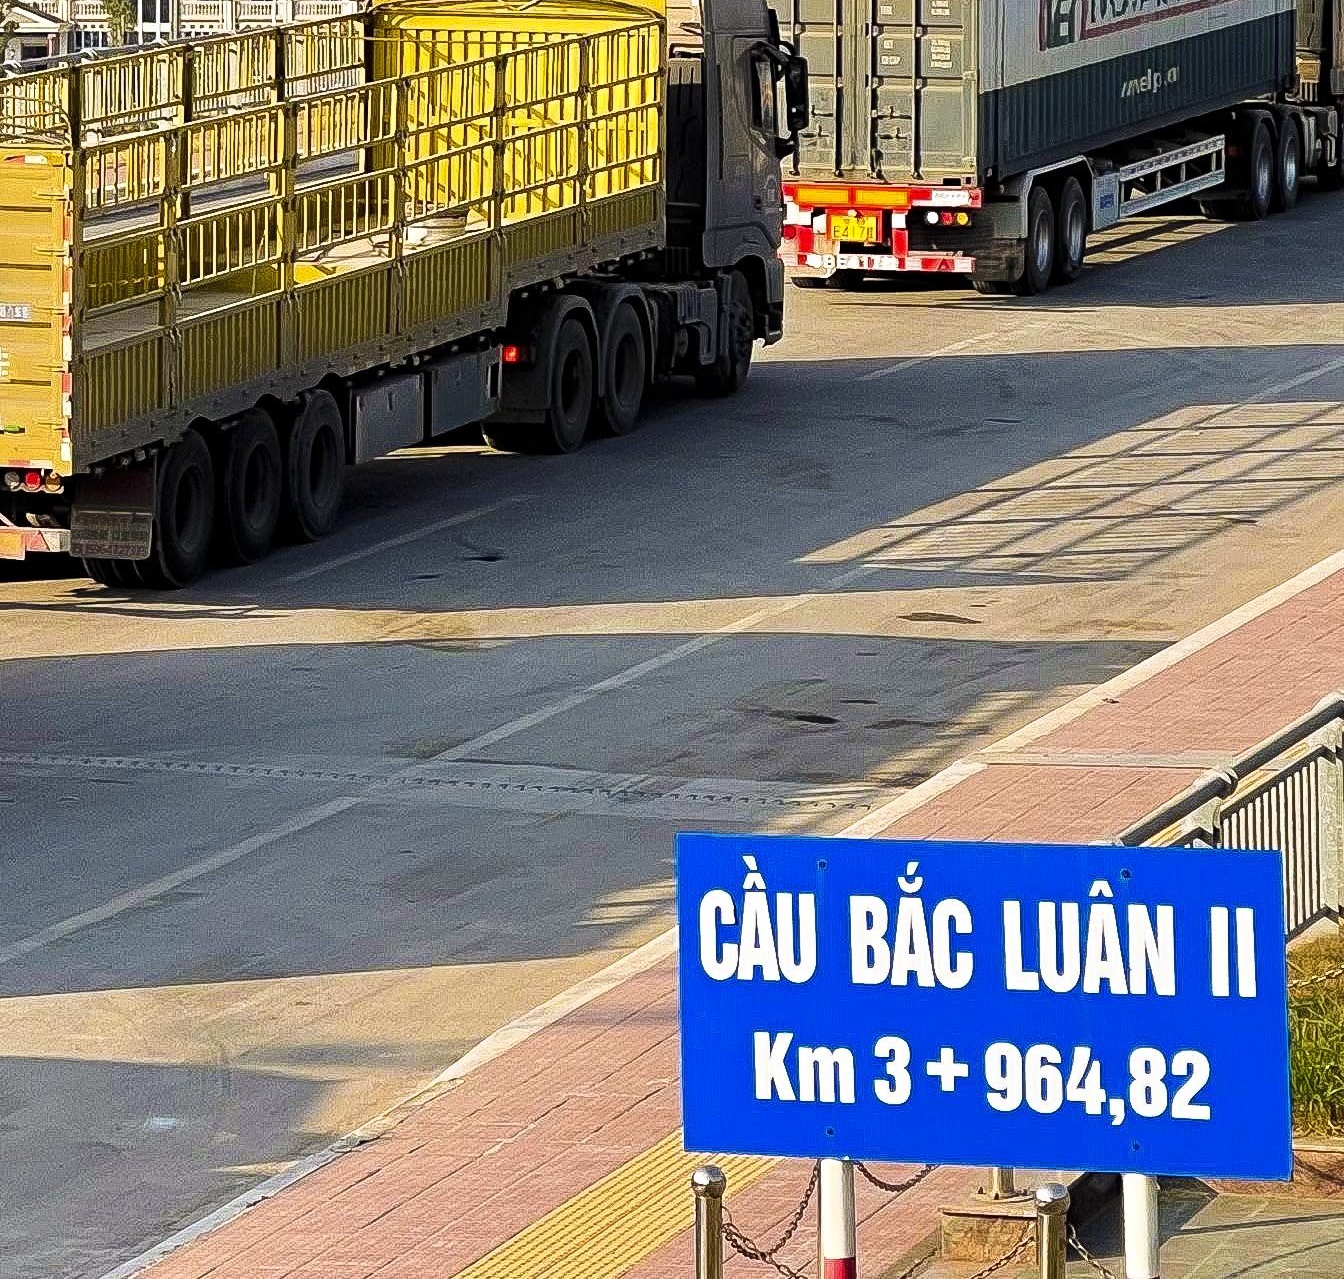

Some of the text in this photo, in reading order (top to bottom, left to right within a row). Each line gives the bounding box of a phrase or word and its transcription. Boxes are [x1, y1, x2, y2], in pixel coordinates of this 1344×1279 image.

[699, 855, 1257, 998] CẦU BẮC LUÂN II
[753, 1031, 856, 1104] Km
